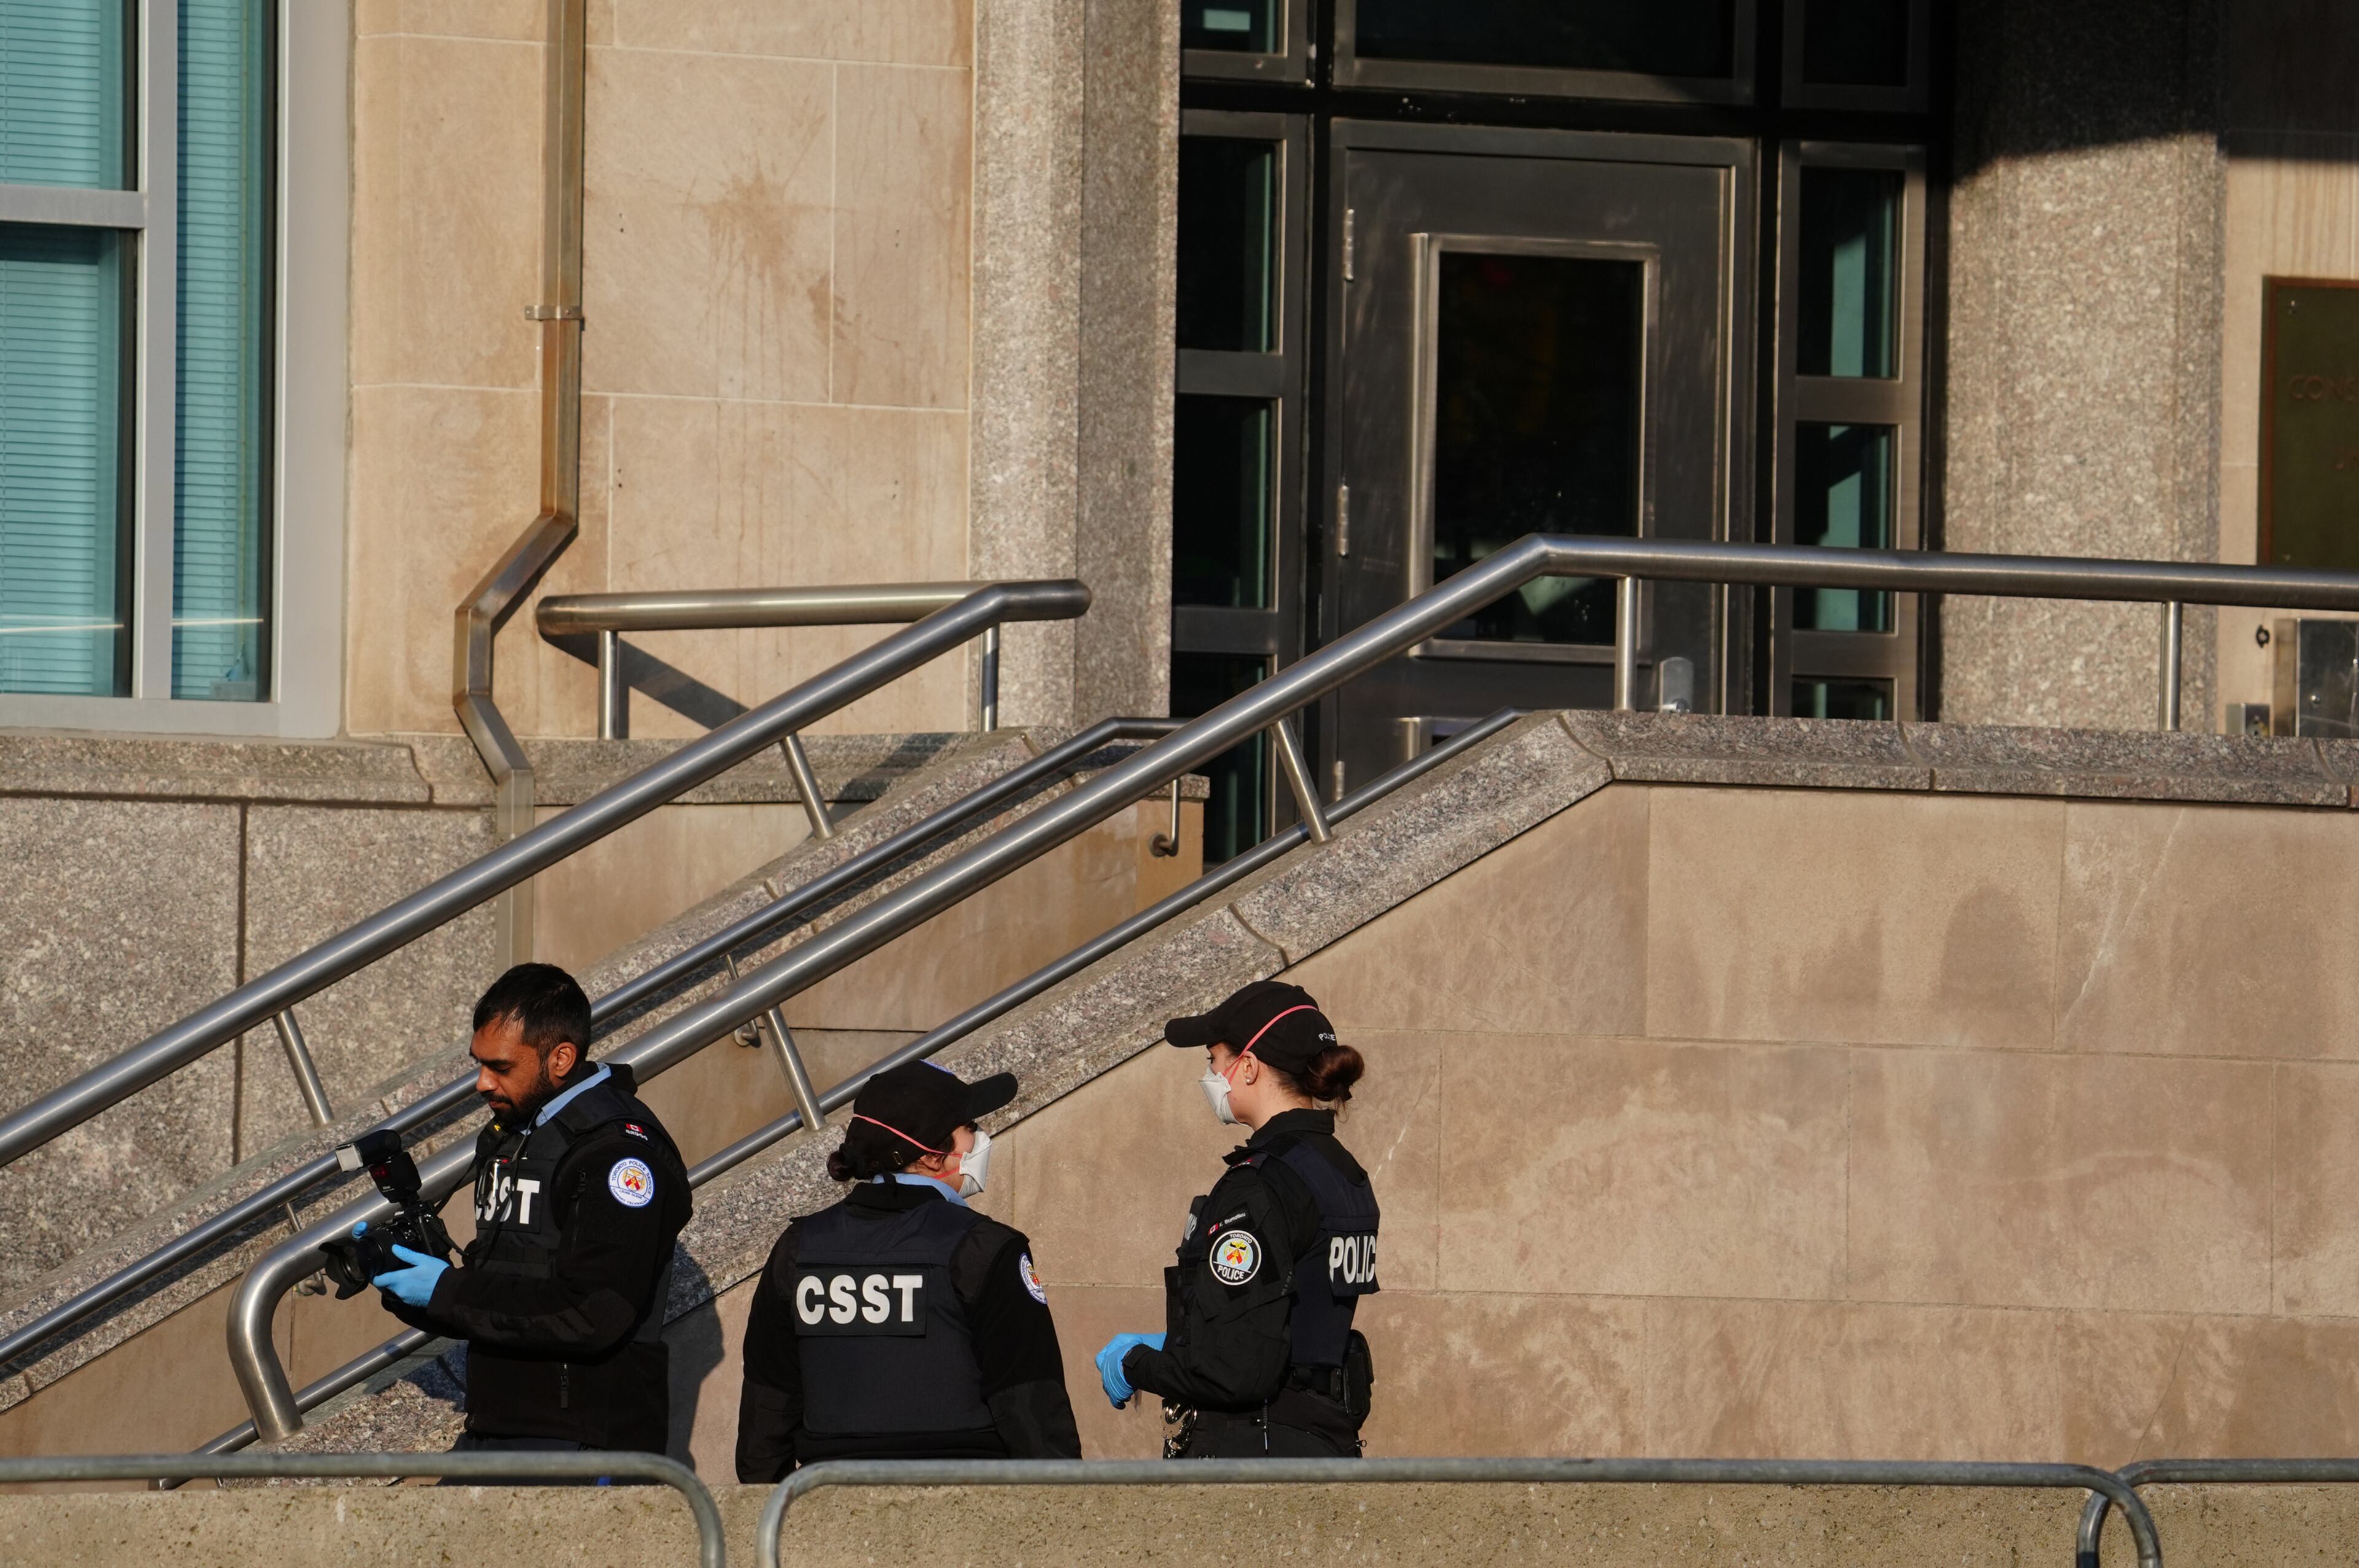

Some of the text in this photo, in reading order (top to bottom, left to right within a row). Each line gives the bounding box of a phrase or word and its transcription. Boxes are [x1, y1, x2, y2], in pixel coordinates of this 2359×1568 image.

[1318, 1032, 1336, 1041] POE
[612, 1161, 627, 1181] TORONTO
[628, 1160, 646, 1171] POLICE
[1229, 1233, 1253, 1244] TORONTO
[1217, 1265, 1245, 1281] POLICE
[796, 1274, 923, 1325] CSST
